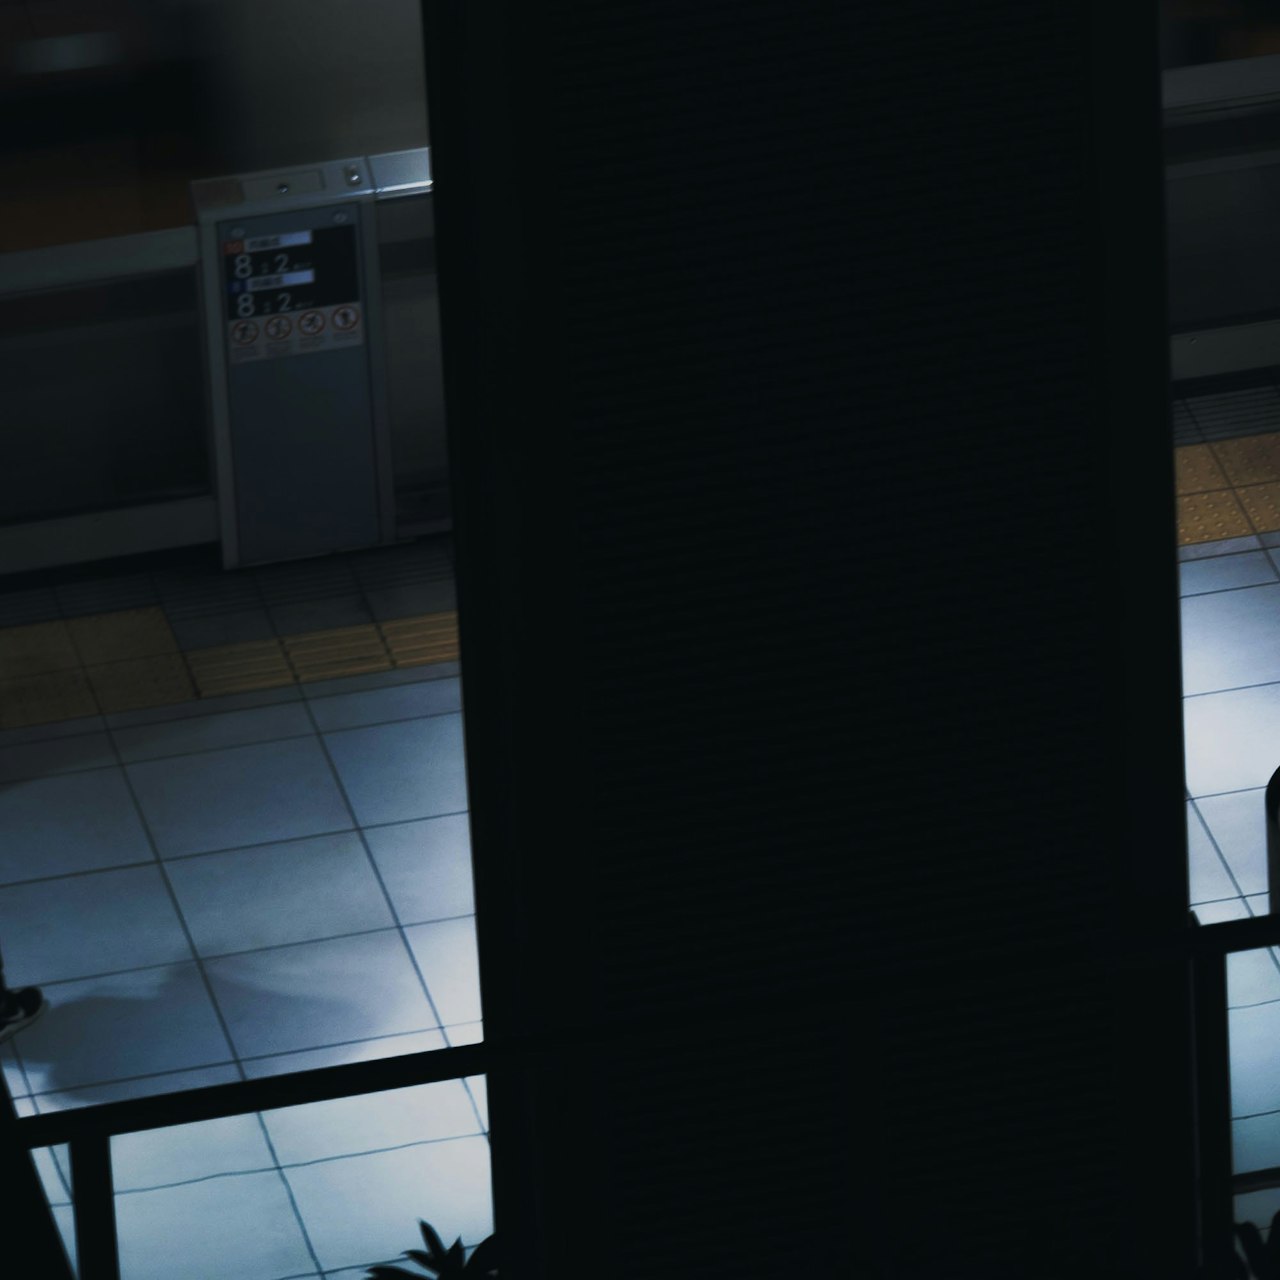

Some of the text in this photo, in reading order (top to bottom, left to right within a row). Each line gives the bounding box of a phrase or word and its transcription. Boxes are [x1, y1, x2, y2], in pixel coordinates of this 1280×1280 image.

[234, 254, 253, 279] 8
[274, 253, 290, 272] 2
[237, 293, 255, 318] 8
[277, 292, 292, 311] 2
